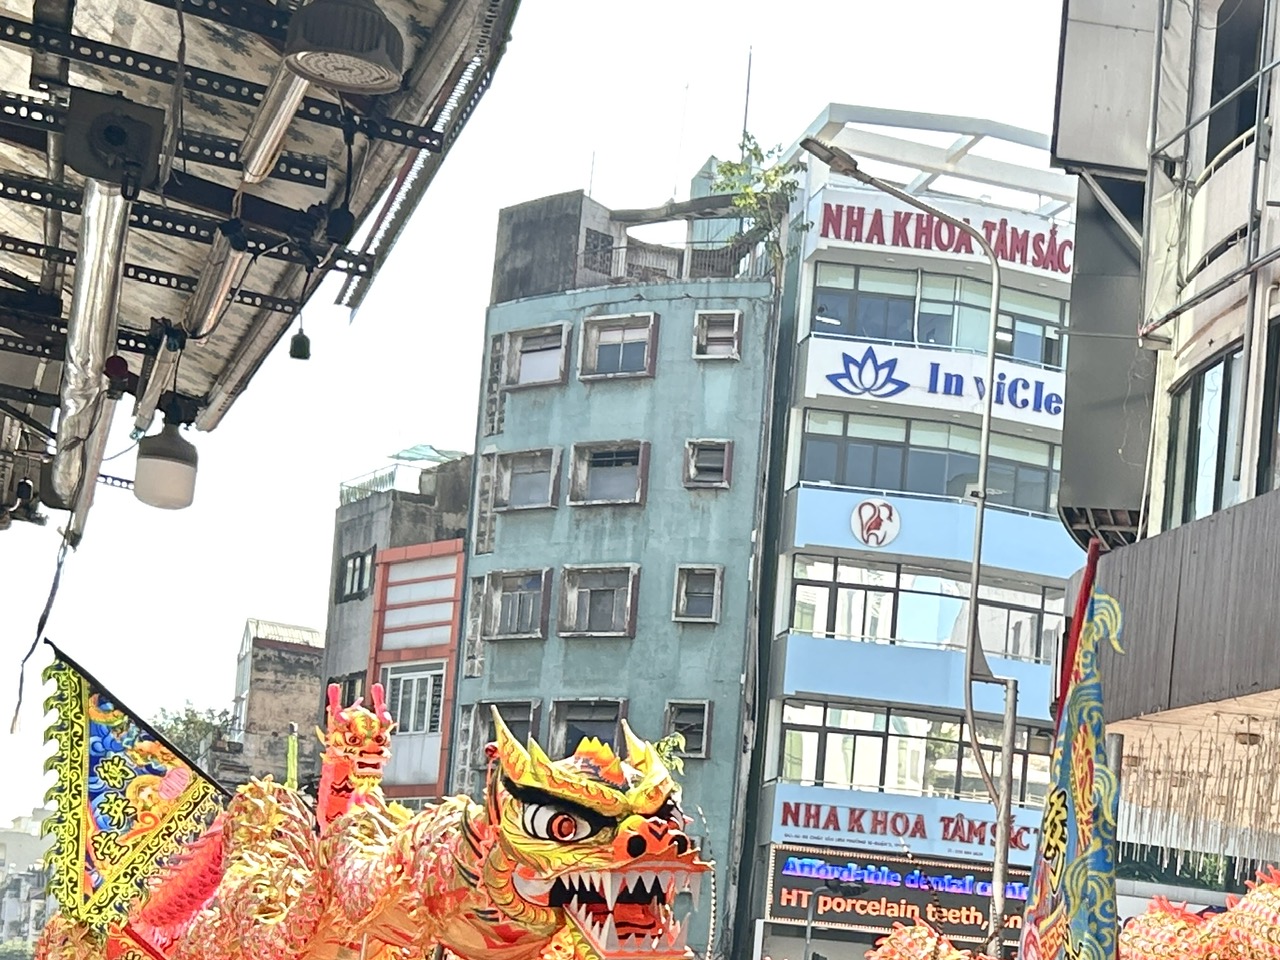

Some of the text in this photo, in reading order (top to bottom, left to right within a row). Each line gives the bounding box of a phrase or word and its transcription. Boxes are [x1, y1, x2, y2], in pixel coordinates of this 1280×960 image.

[820, 203, 1073, 273] NHA KHOA TÂM SẮC
[781, 802, 841, 831] NHA
[847, 807, 927, 839] KHOA
[940, 813, 988, 845] TÂM
[781, 888, 813, 908] HT
[817, 894, 920, 918] porcelain
[926, 903, 988, 931] teeth,
